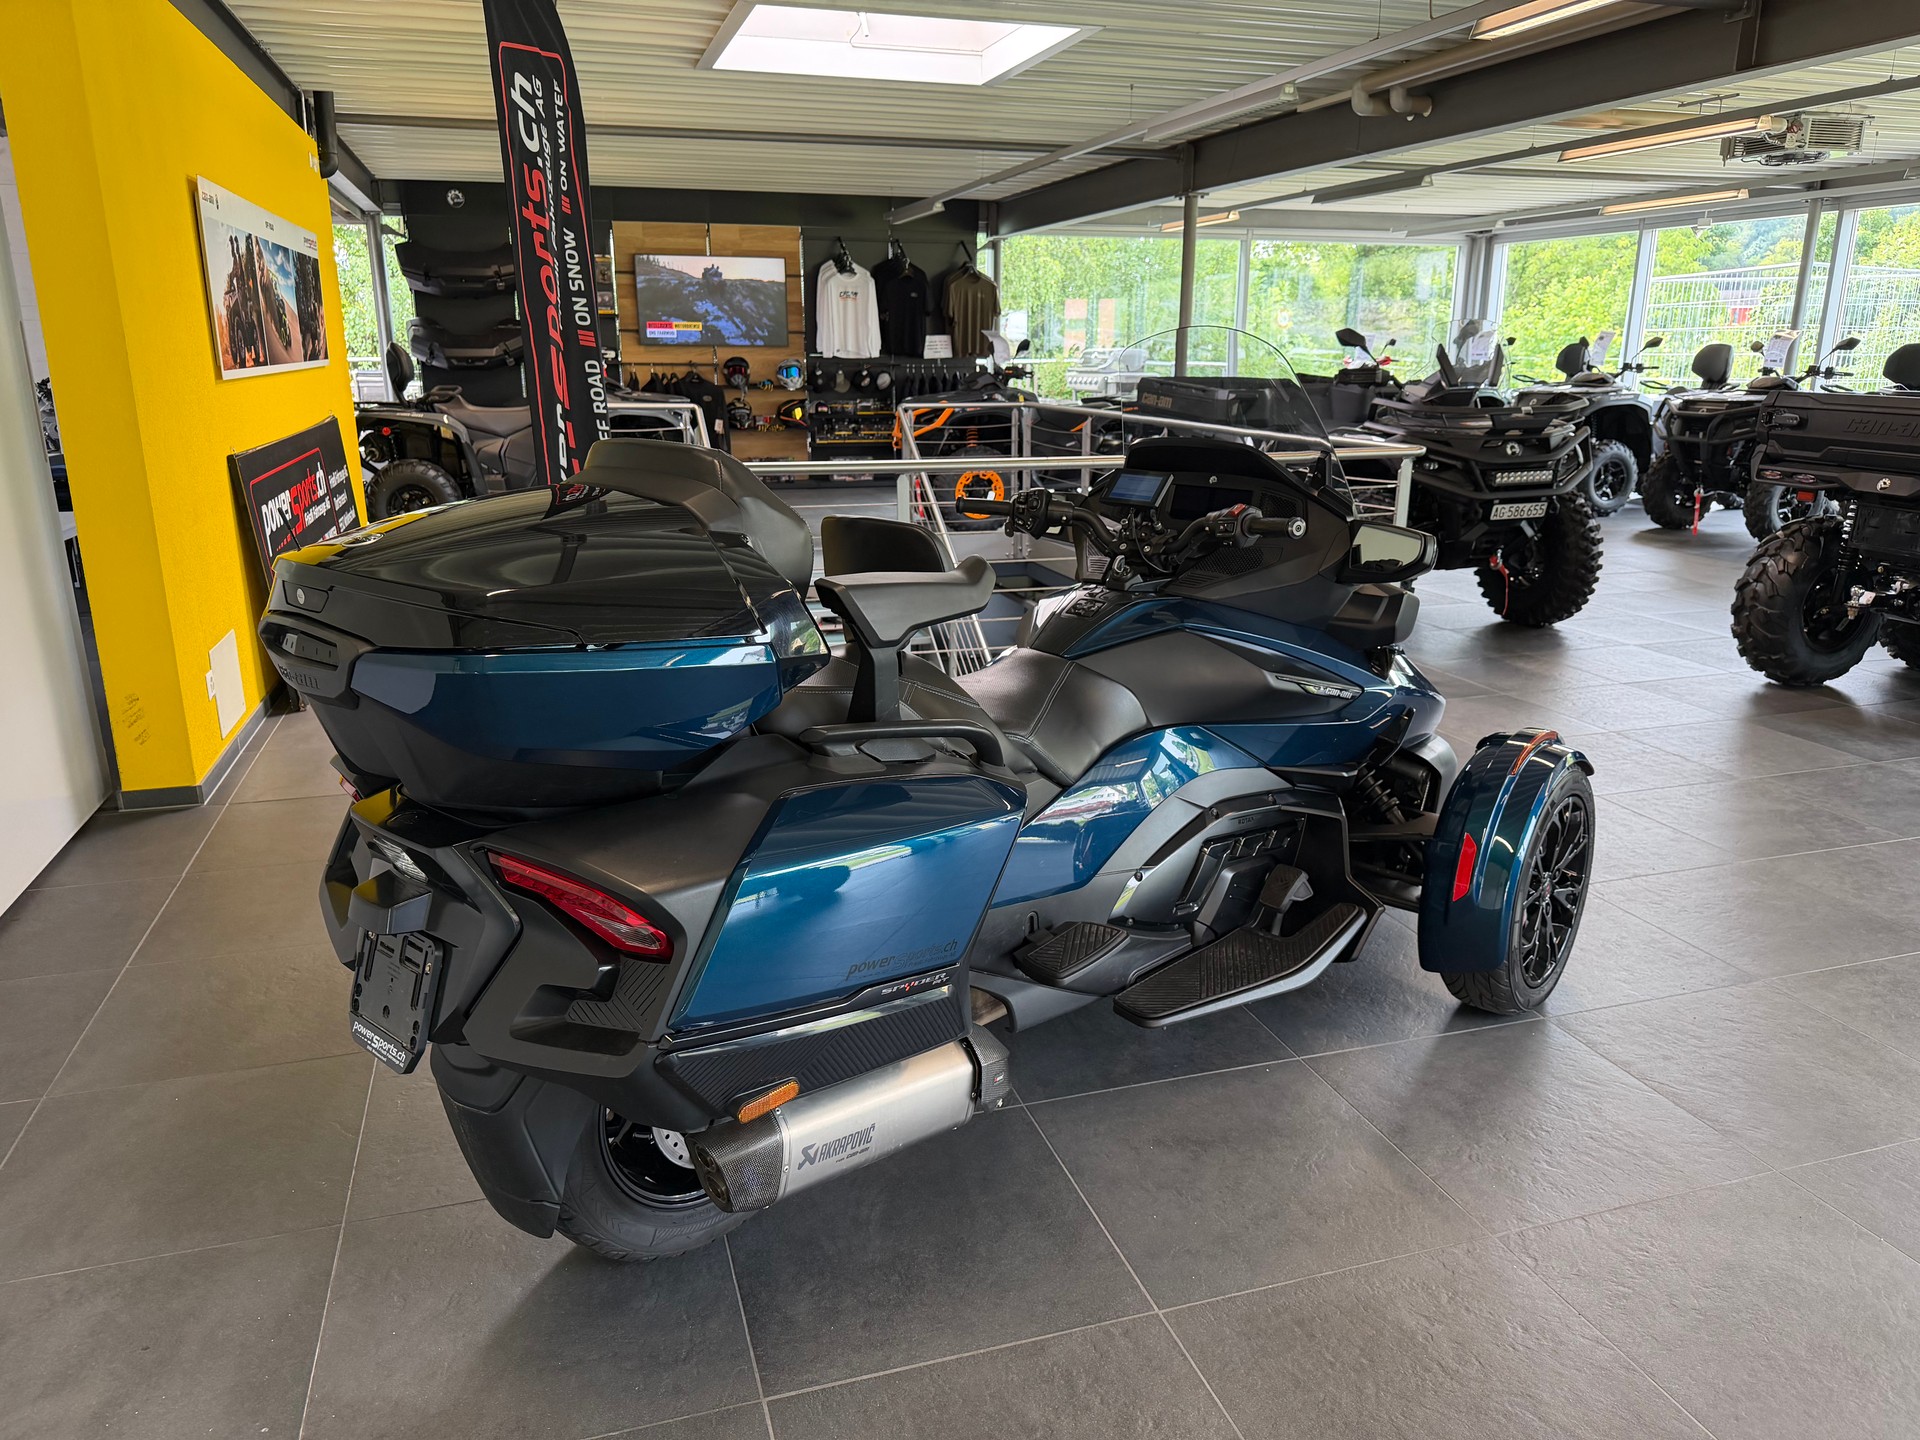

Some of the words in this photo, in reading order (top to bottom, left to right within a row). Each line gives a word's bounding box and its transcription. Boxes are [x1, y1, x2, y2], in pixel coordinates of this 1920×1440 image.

[531, 74, 547, 118] AG
[559, 160, 569, 192] ON
[563, 226, 585, 292] SNOW
[572, 296, 592, 327] ON
[584, 359, 607, 414] ROAD
[1842, 417, 1920, 438] can-a
